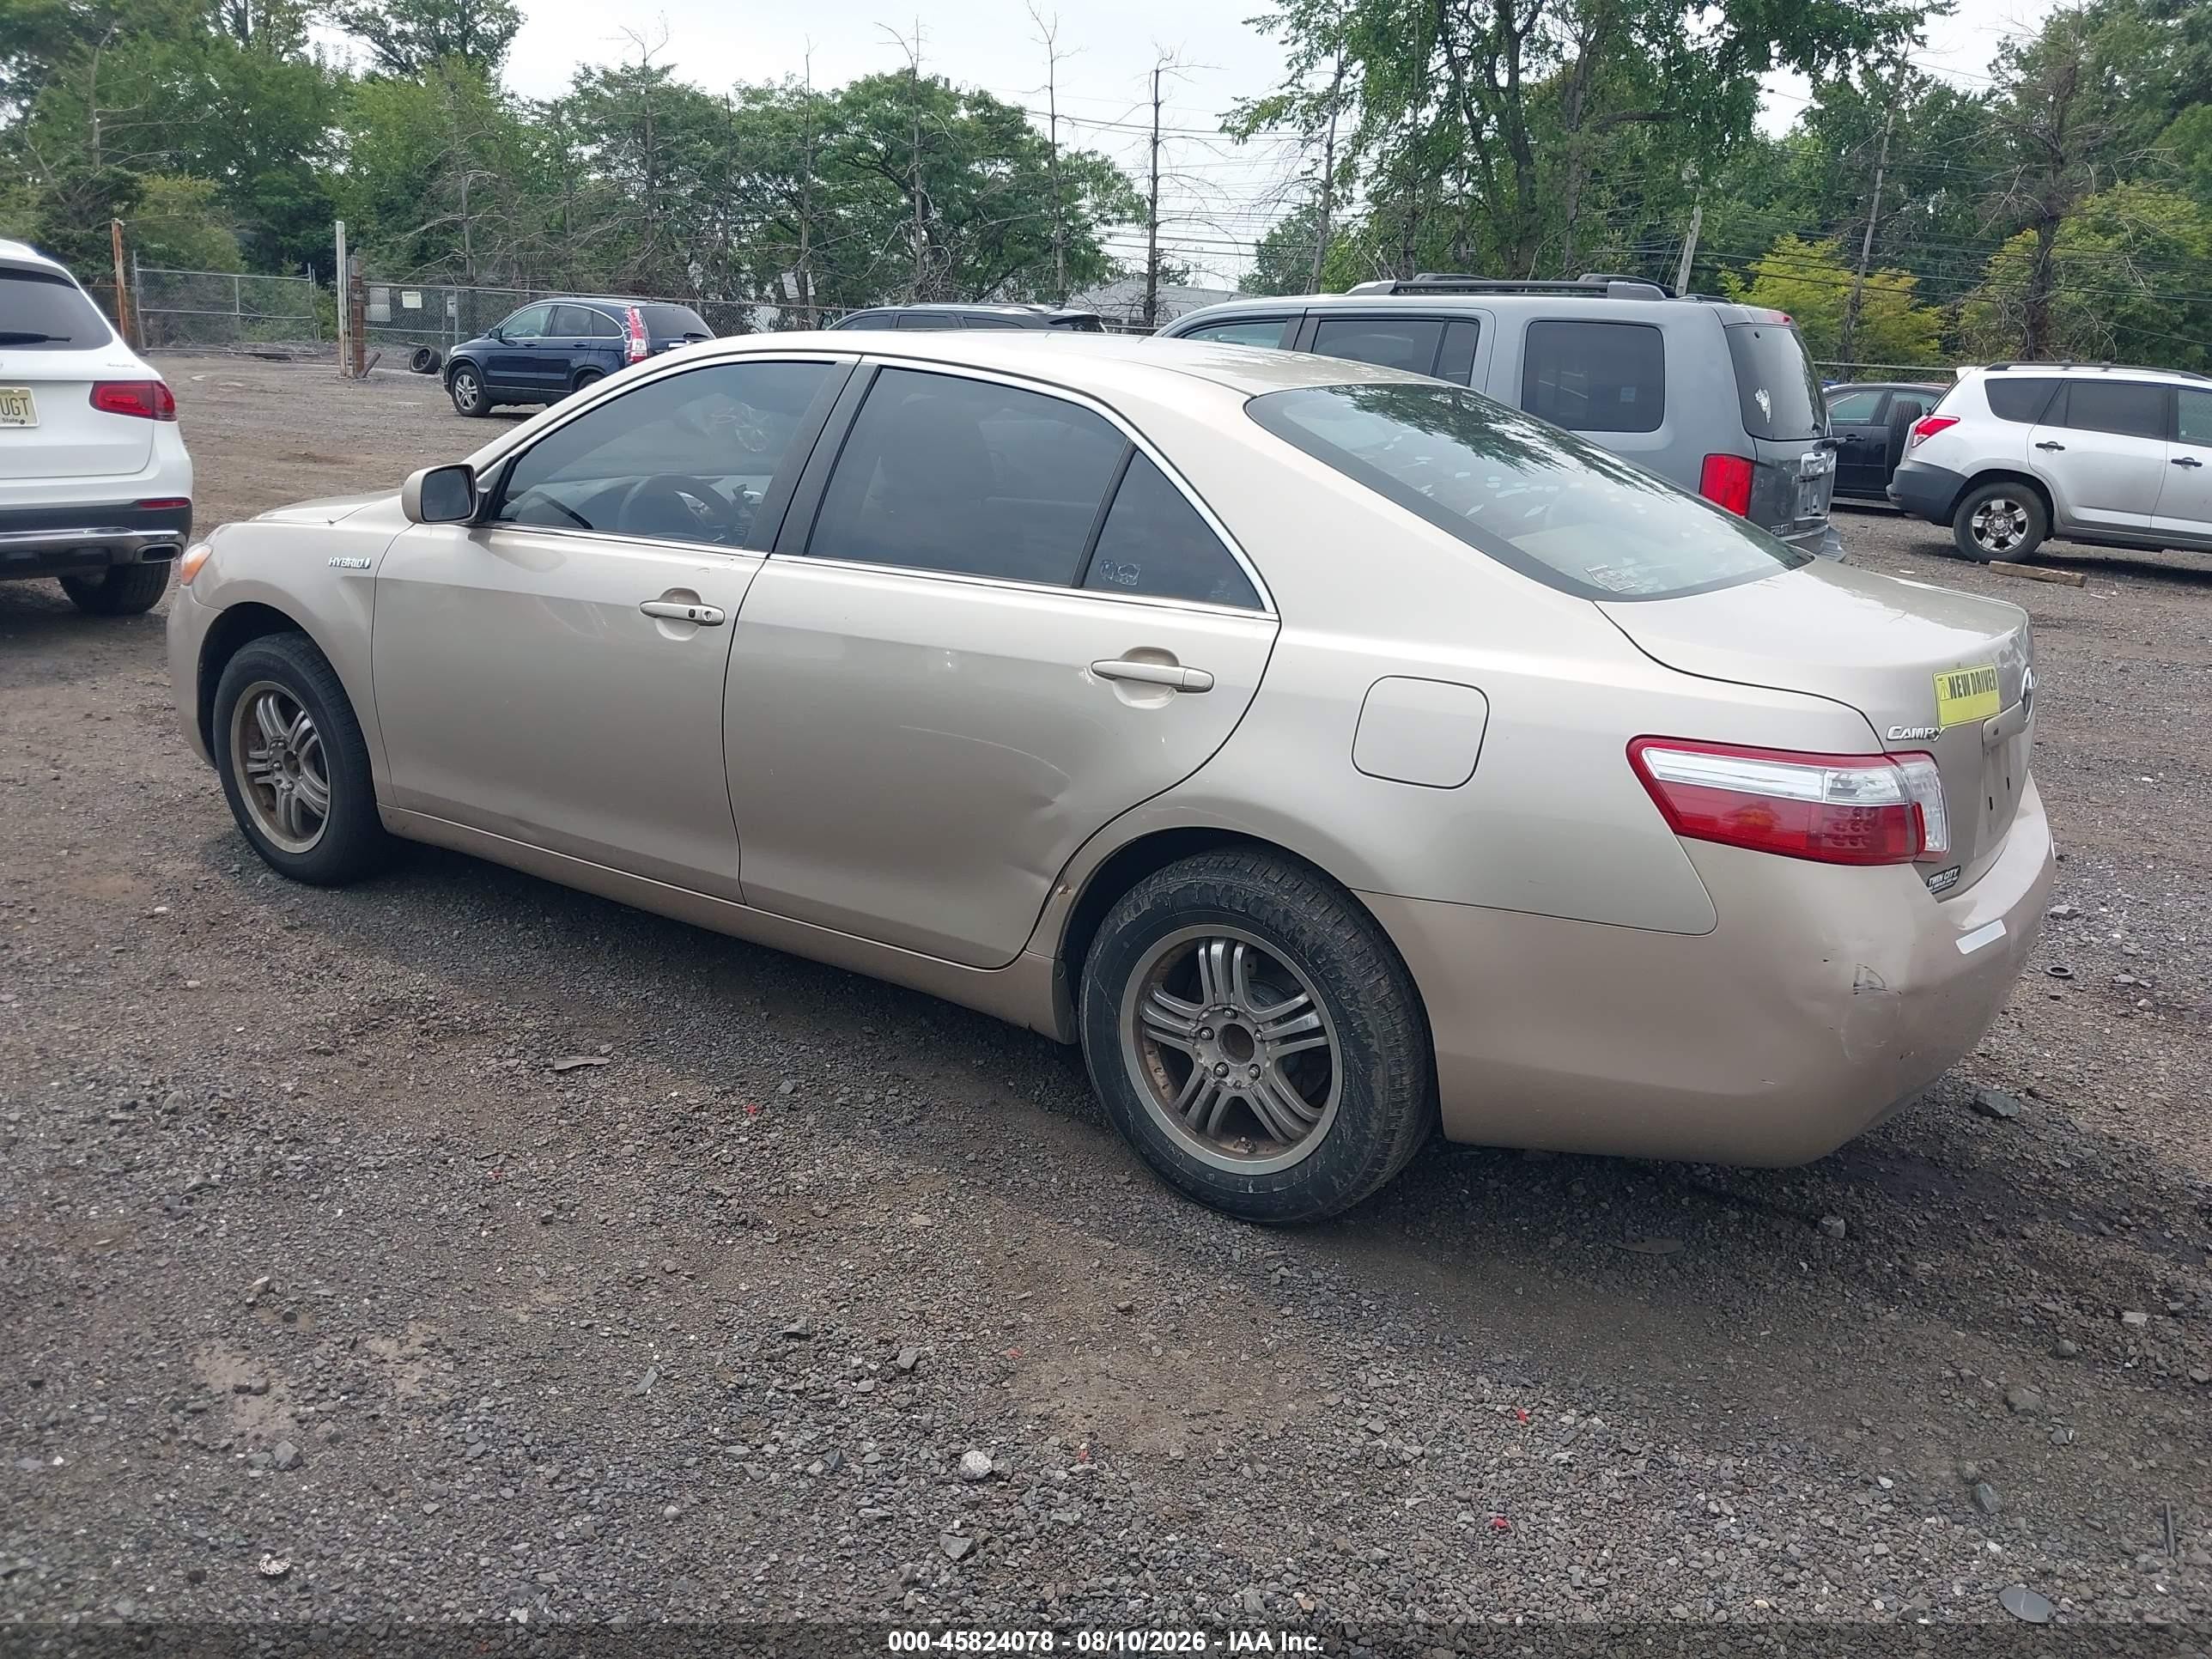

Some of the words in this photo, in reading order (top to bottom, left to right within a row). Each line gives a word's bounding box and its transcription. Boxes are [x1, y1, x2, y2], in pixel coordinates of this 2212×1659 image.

[0, 398, 28, 416] UGT
[329, 557, 364, 568] HYBRID
[1948, 673, 1971, 700] NEW
[1970, 669, 1997, 695] DRIVER
[1943, 867, 1959, 880] CITY
